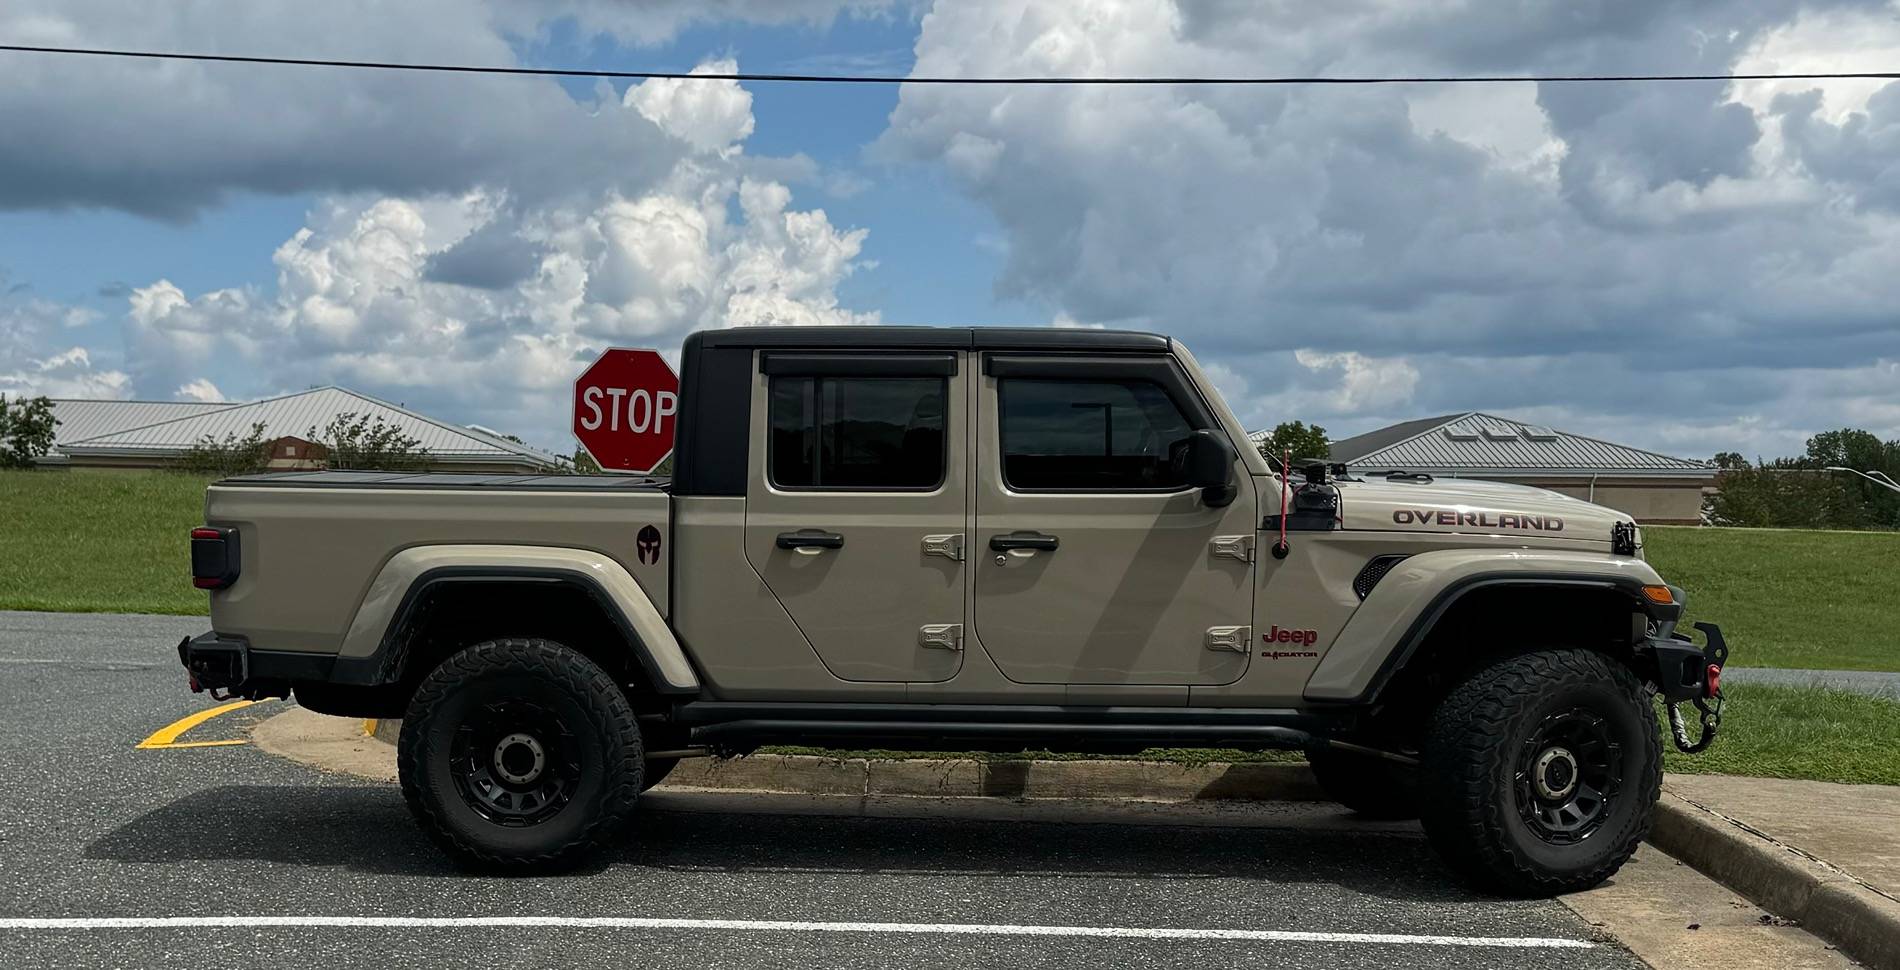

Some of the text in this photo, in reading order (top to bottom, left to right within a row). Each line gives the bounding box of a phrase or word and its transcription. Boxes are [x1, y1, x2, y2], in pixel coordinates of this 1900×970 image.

[580, 386, 678, 434] STOP
[1392, 509, 1564, 532] OVERLAND
[1262, 625, 1317, 646] Jeep
[1261, 651, 1318, 660] GLADIATOR
